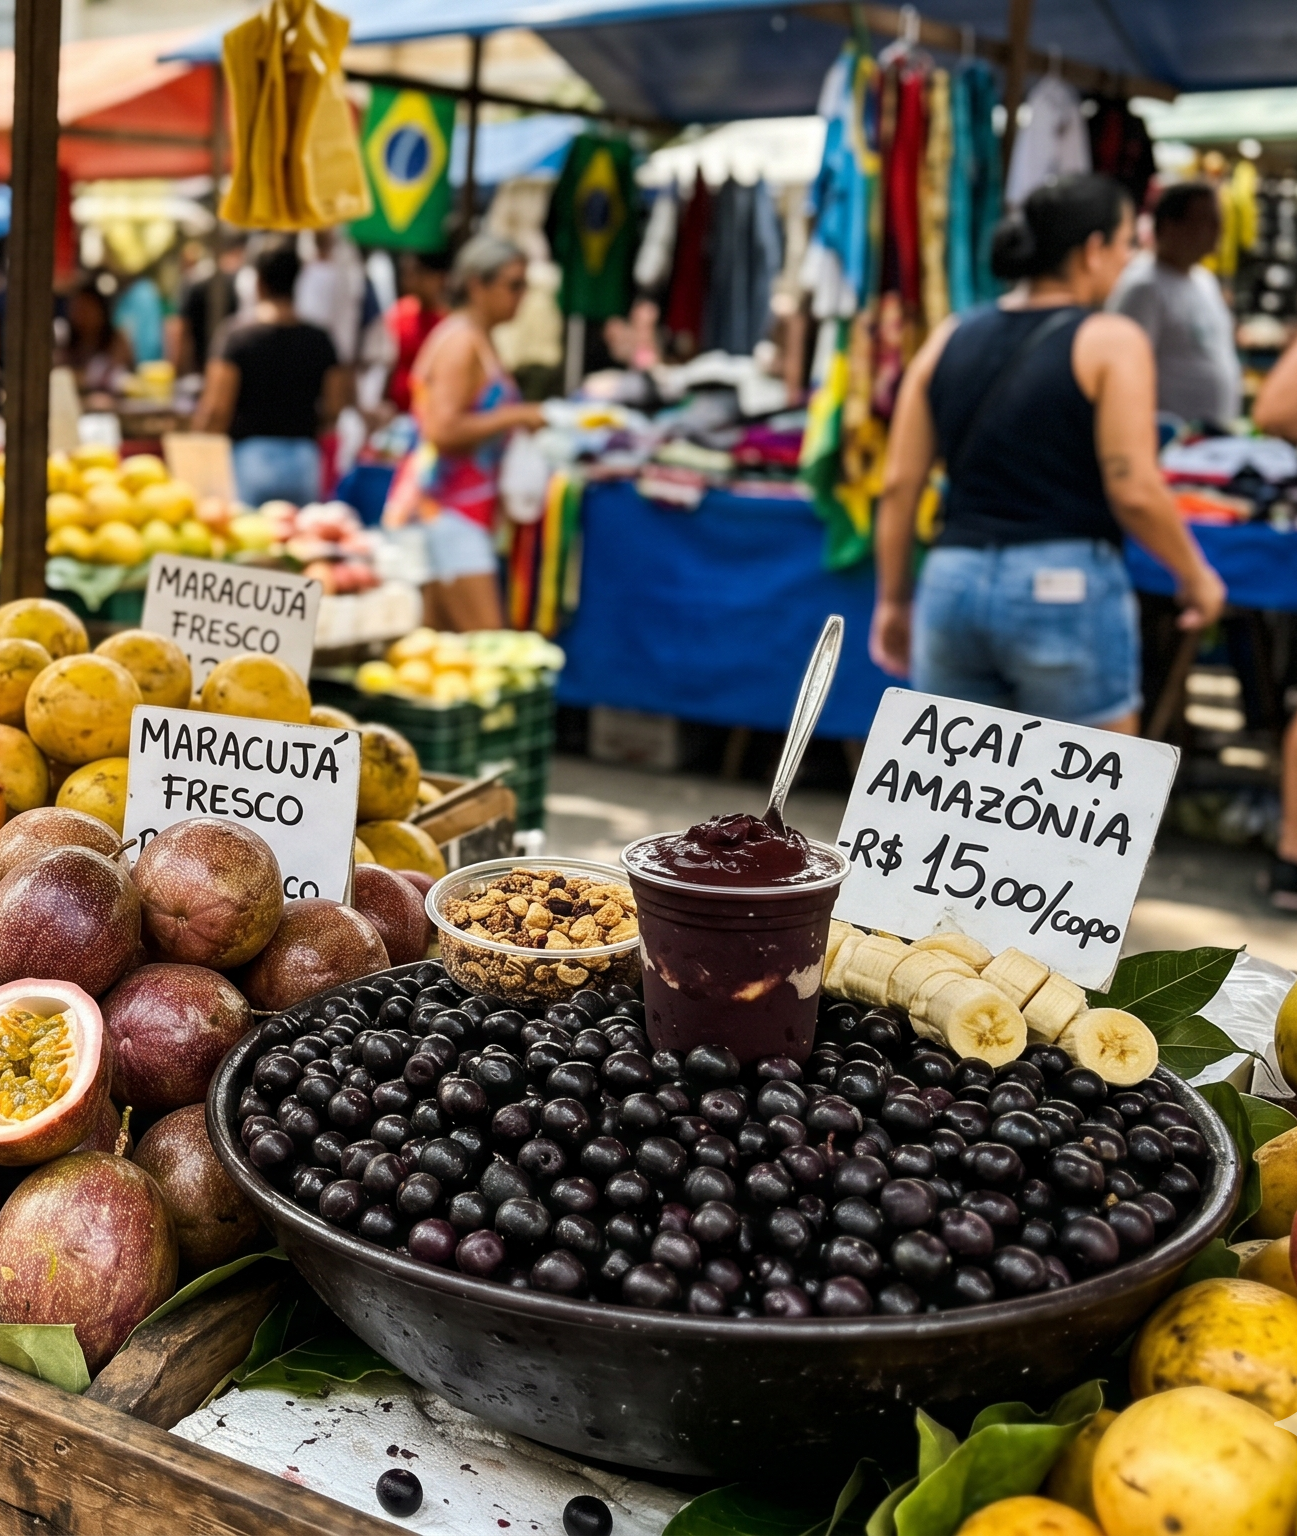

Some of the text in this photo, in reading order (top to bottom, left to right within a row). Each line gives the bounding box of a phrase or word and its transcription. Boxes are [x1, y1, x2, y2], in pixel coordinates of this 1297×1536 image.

[156, 565, 315, 621] MARACUJÁ
[172, 610, 281, 655] FRESCO
[140, 717, 350, 784] MARACUJÁ
[901, 704, 1123, 791] AÇAÍ DA
[161, 773, 304, 826] FRESCO
[913, 833, 1121, 950] 15,00/copo
